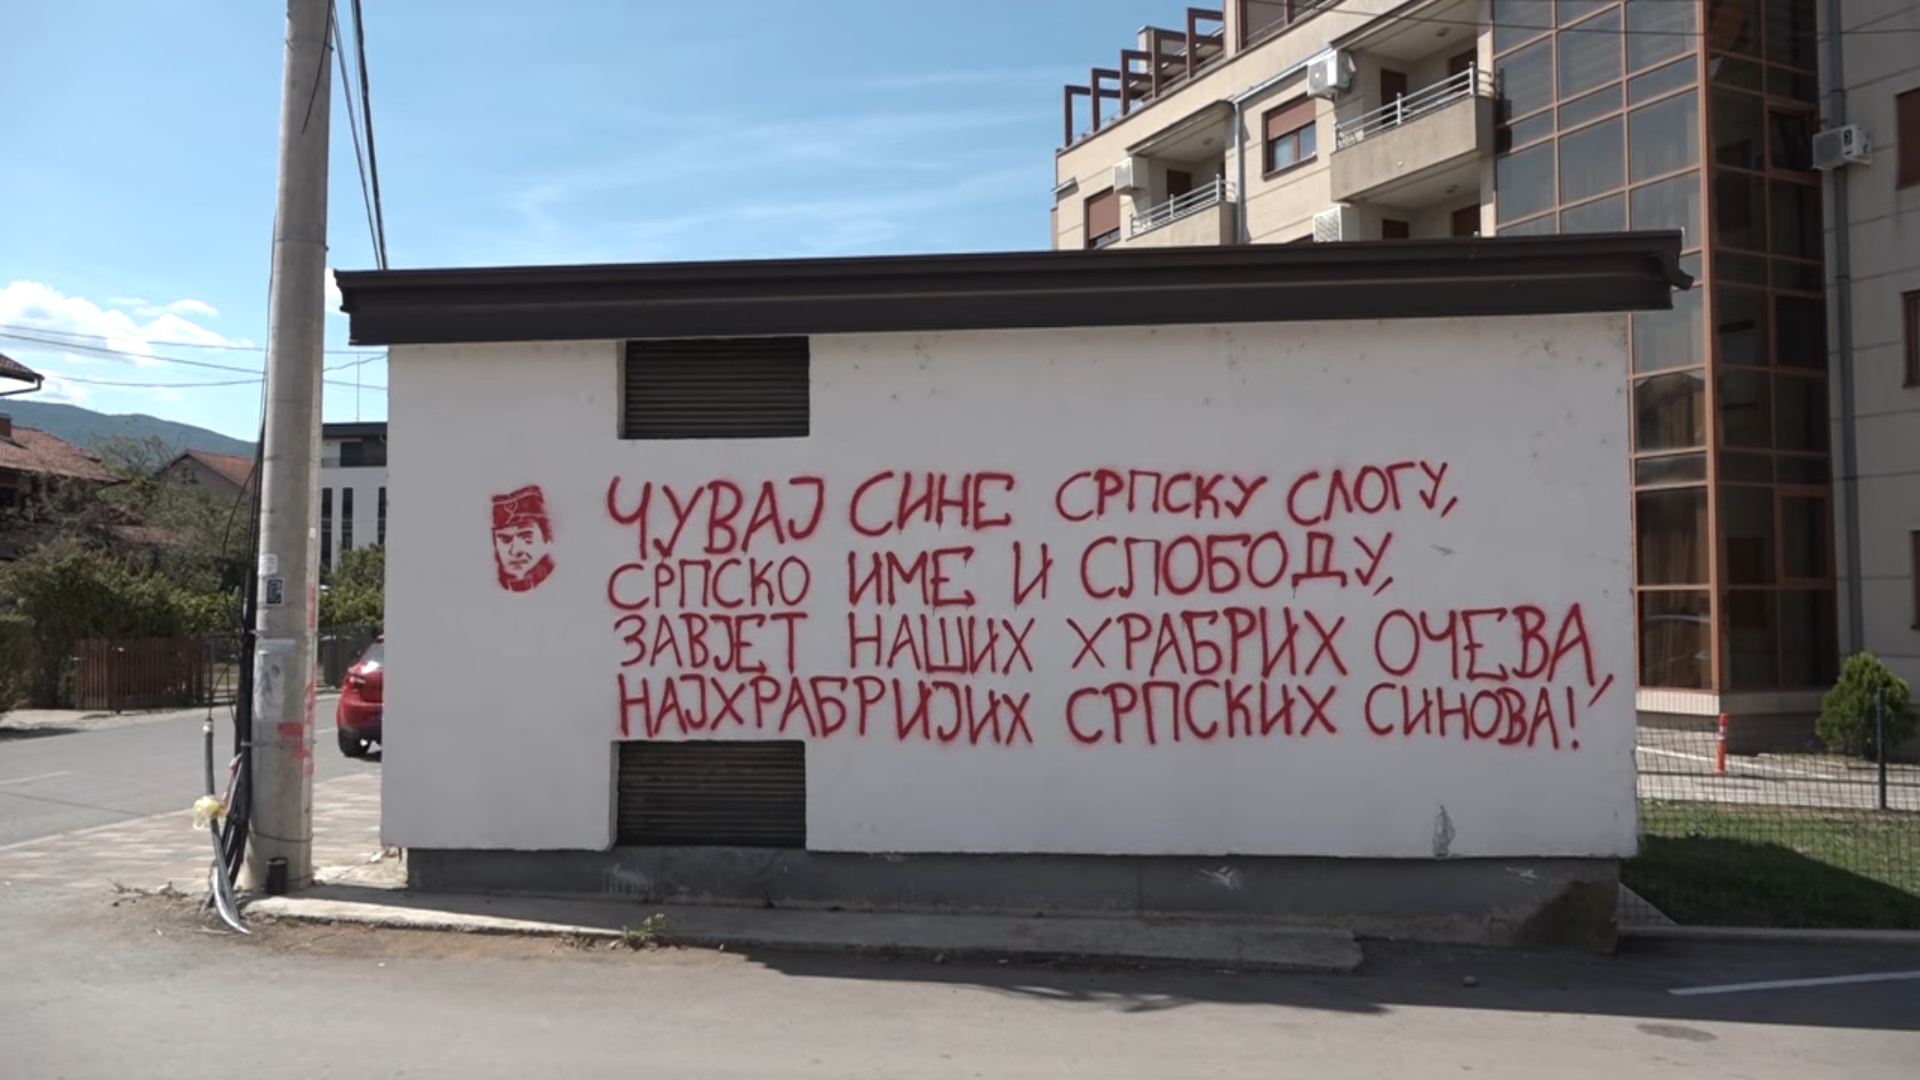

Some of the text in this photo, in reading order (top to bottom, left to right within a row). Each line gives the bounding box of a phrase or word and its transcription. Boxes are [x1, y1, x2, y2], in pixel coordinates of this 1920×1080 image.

[607, 476, 824, 559] ЧУВАЈ
[850, 471, 1015, 532] СИНЕ
[1056, 469, 1268, 521] СРПСКУ
[607, 556, 811, 609] СРПСКО
[848, 546, 976, 606] ИМЕ
[1014, 541, 1053, 606] И
[613, 612, 808, 674] ЗАВЈЕТ
[848, 612, 1036, 675] НАШИХ
[1066, 606, 1347, 678] ХРАБРИХ
[617, 673, 1581, 750] НАЈХРАБРИЈИХ СРПСКИХ СИНОВА!
